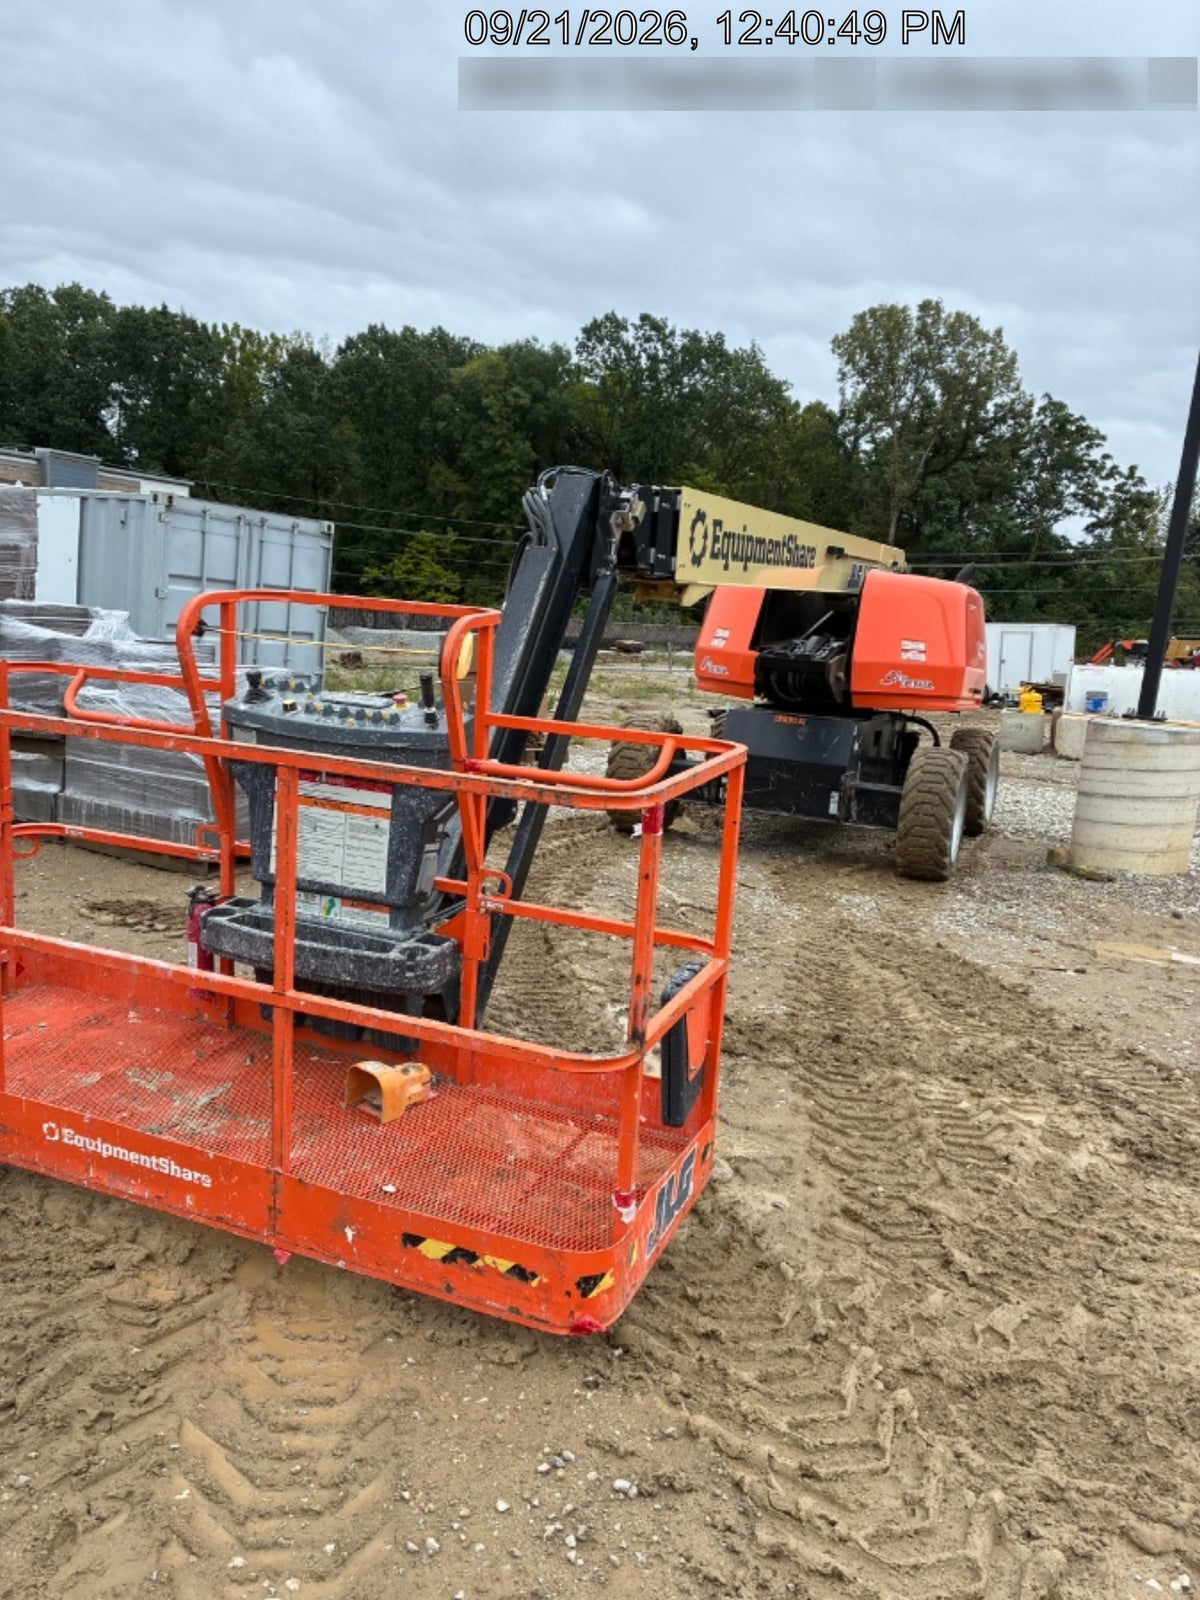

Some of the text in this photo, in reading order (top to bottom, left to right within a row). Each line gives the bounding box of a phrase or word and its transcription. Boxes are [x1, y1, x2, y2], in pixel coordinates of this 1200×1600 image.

[710, 518, 817, 572] EquipmentShare
[61, 1126, 212, 1188] EquipmentShare
[645, 1141, 698, 1261] JLG
